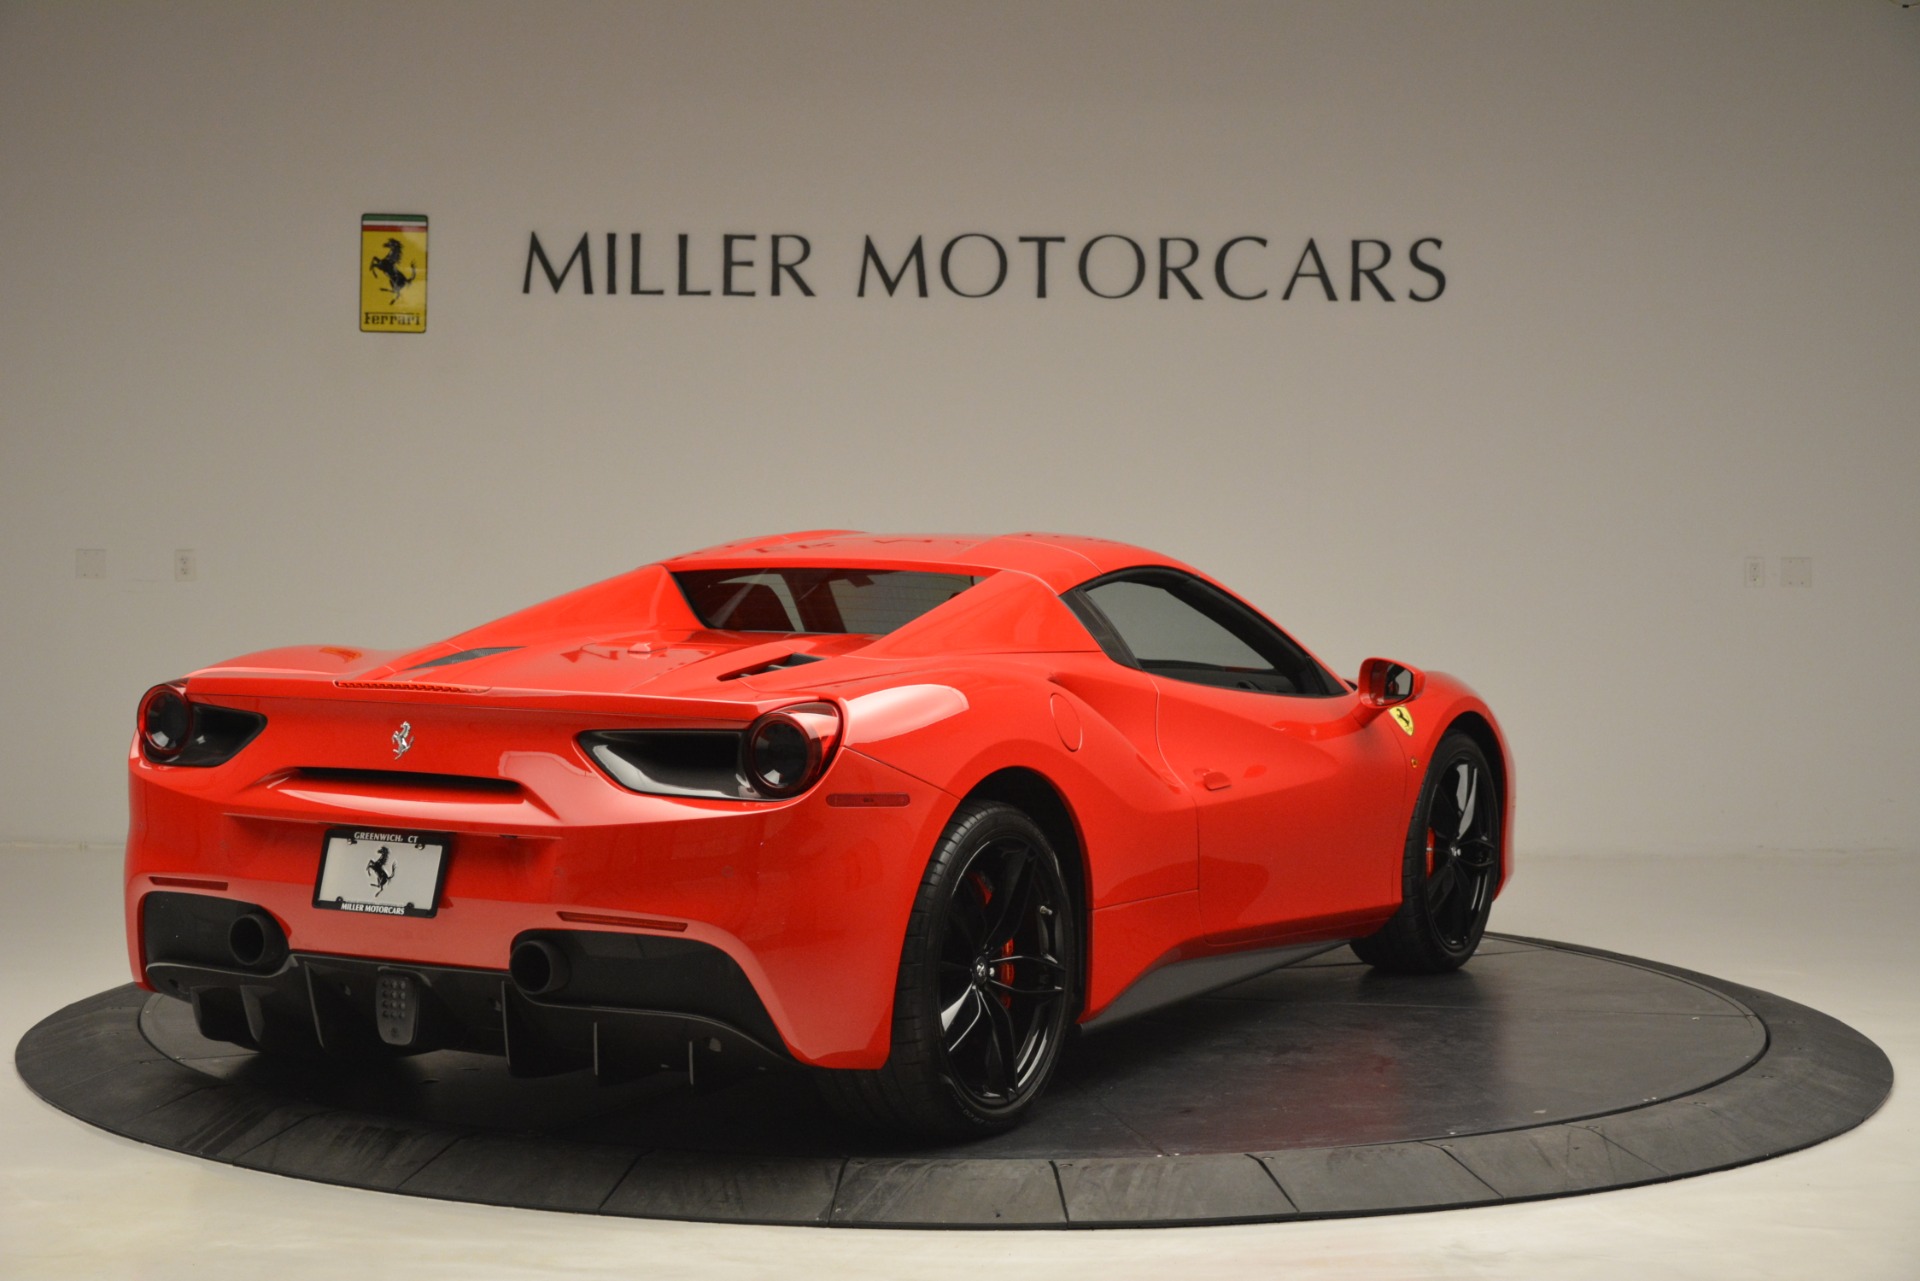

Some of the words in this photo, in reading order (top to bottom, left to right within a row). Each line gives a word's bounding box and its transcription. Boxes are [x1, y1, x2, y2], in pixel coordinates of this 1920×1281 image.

[522, 231, 816, 297] MILLER
[857, 233, 1446, 303] MOTORCARS
[364, 312, 420, 325] Ferrari
[408, 835, 418, 843] CT
[341, 903, 364, 911] MILLER
[365, 904, 405, 915] MOTORCARS
